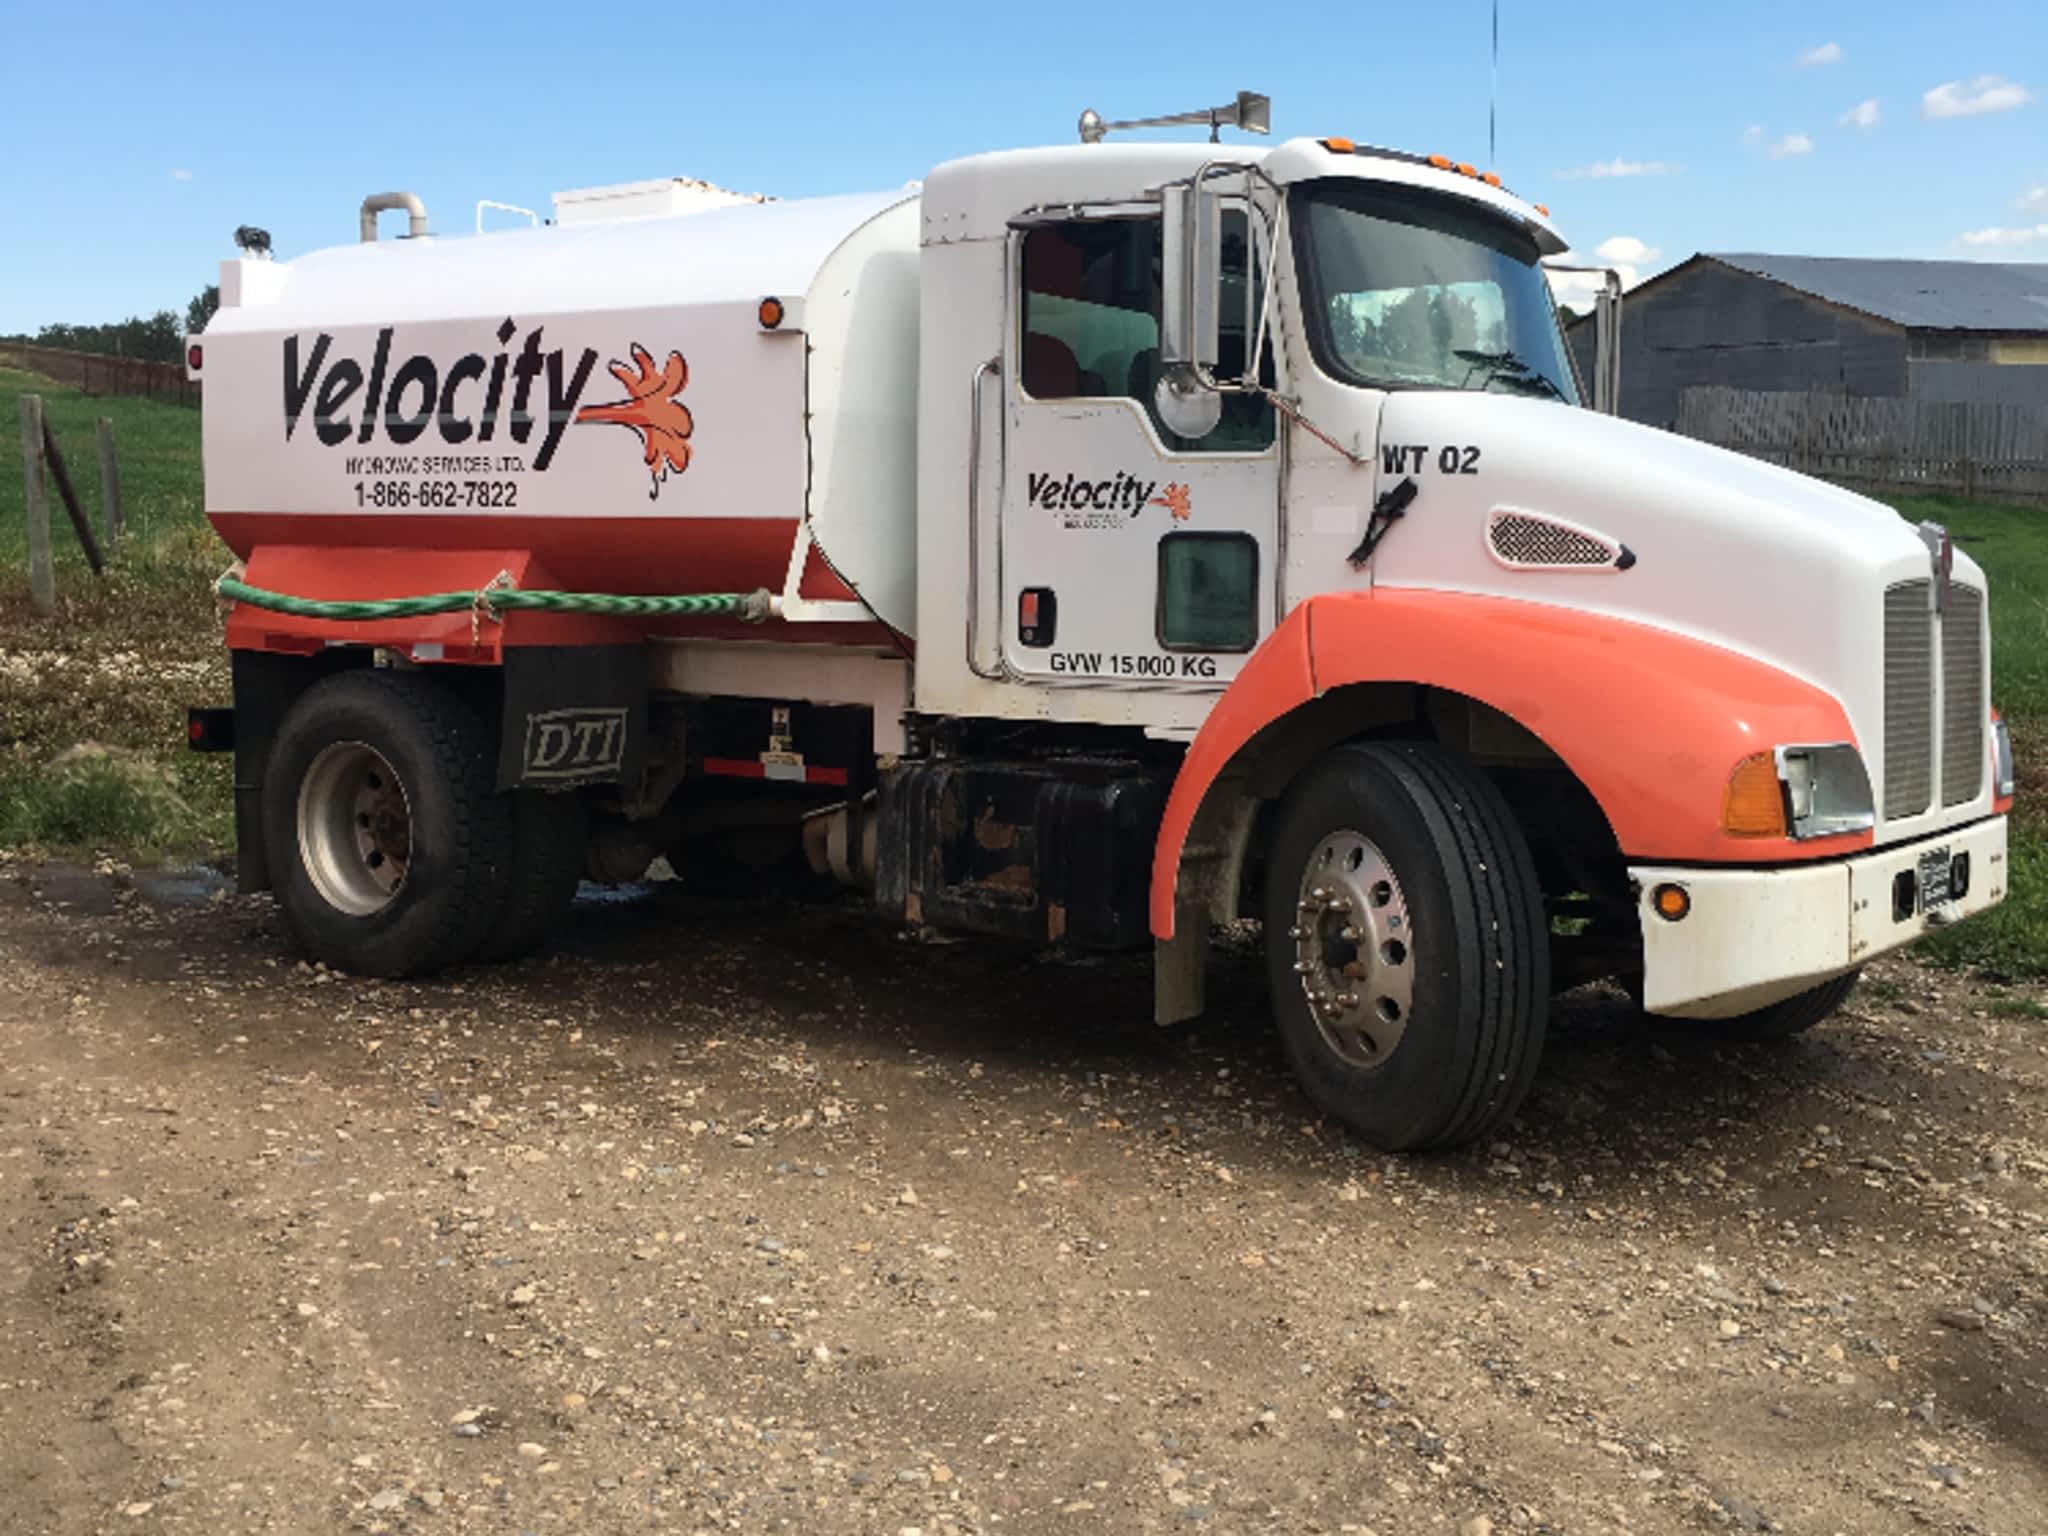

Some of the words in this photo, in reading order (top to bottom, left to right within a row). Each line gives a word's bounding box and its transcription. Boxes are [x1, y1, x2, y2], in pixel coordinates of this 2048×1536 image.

[283, 316, 599, 473] Velocity
[422, 456, 493, 475] SERVICES
[1381, 445, 1429, 475] WT
[1438, 445, 1481, 475] 02
[354, 480, 517, 508] 1-866-662-7822
[1028, 470, 1156, 518] Velocity
[1050, 652, 1102, 674] GVW
[1181, 656, 1217, 678] KG
[532, 720, 619, 767] DTI
